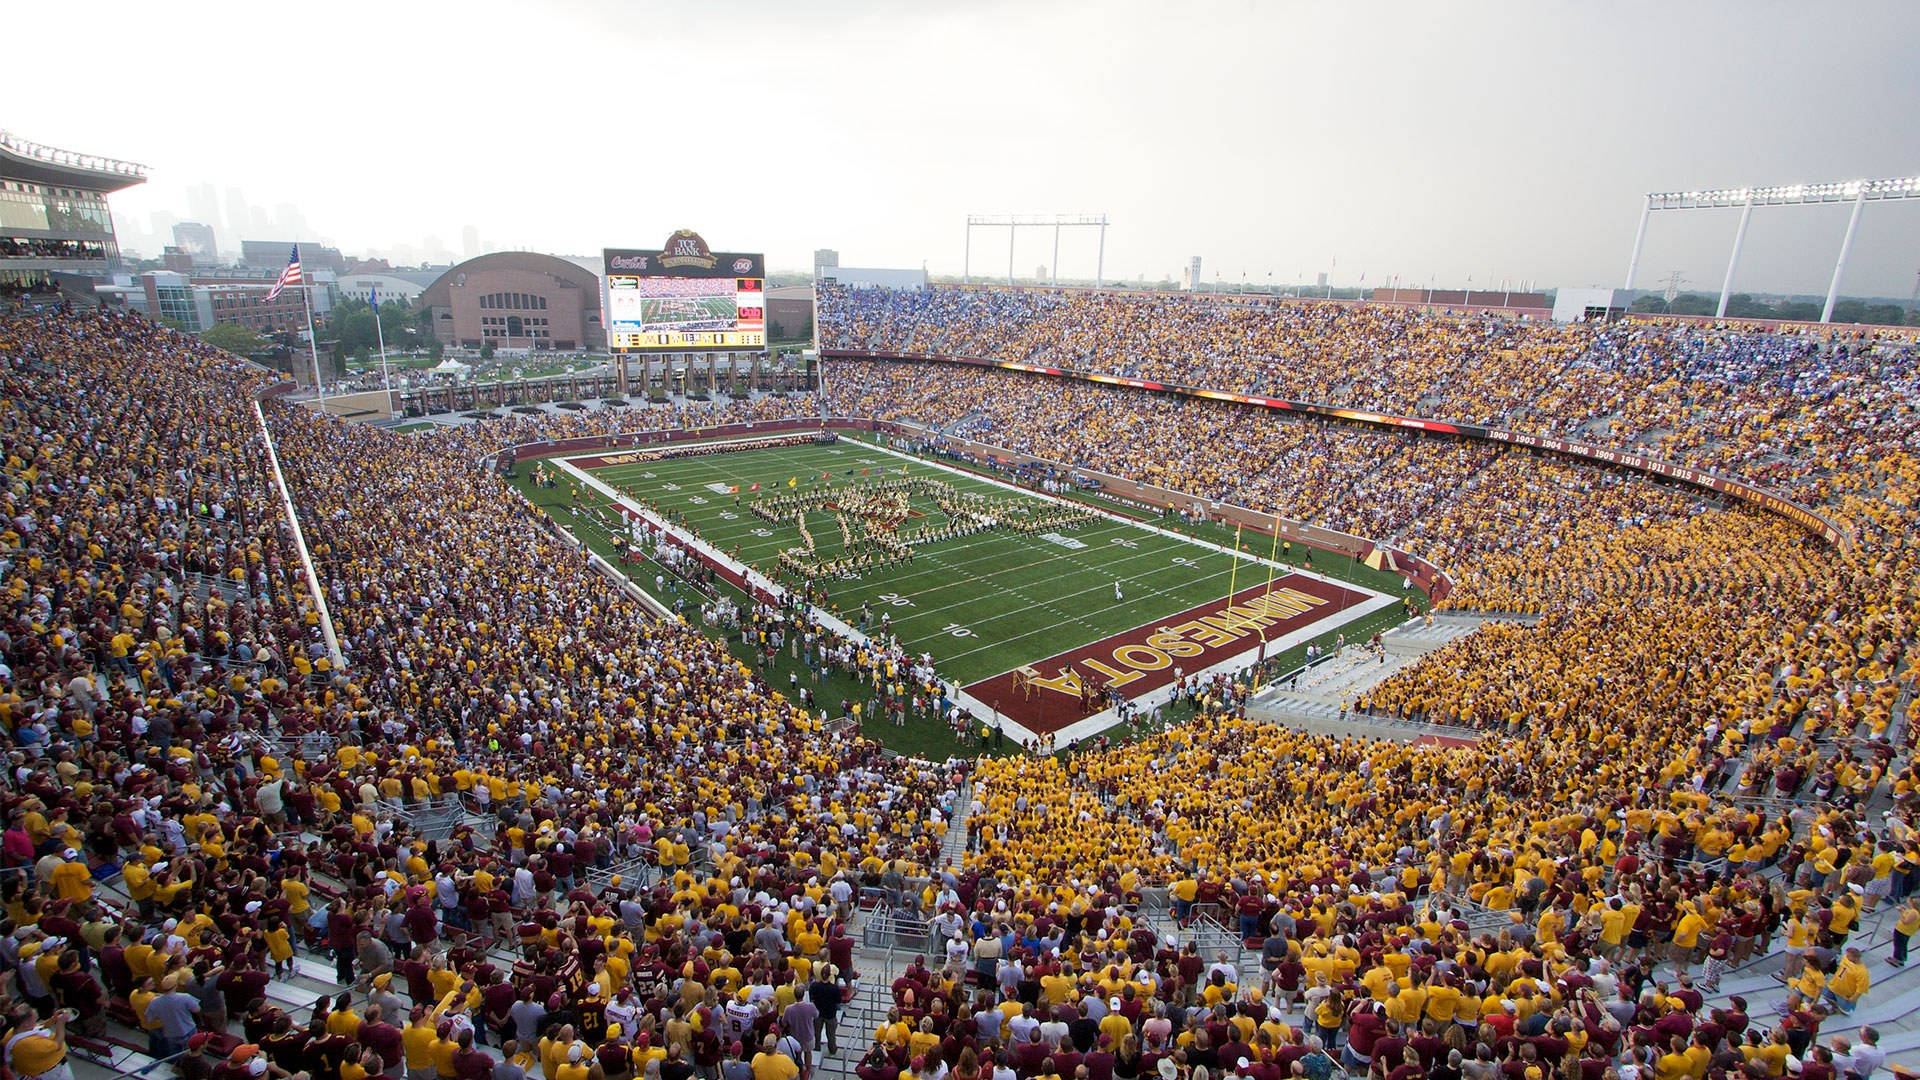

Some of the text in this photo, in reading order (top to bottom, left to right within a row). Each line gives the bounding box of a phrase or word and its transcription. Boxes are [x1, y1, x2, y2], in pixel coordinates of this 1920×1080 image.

[674, 247, 701, 257] BANK
[677, 239, 697, 249] TCF
[1489, 430, 1509, 441] 1900
[1515, 435, 1536, 445] 1903
[1541, 439, 1561, 450] 1904
[1594, 449, 1615, 461] 1909
[1620, 455, 1641, 467] 1910
[1647, 461, 1666, 473] 1911
[1671, 467, 1692, 480] 1915
[1697, 474, 1716, 487] 1927
[1724, 482, 1742, 495] BIG
[1746, 490, 1762, 502] TEN
[878, 592, 910, 606] 20
[1028, 587, 1330, 698] MINNESOTA
[583, 1011, 599, 1030] 21
